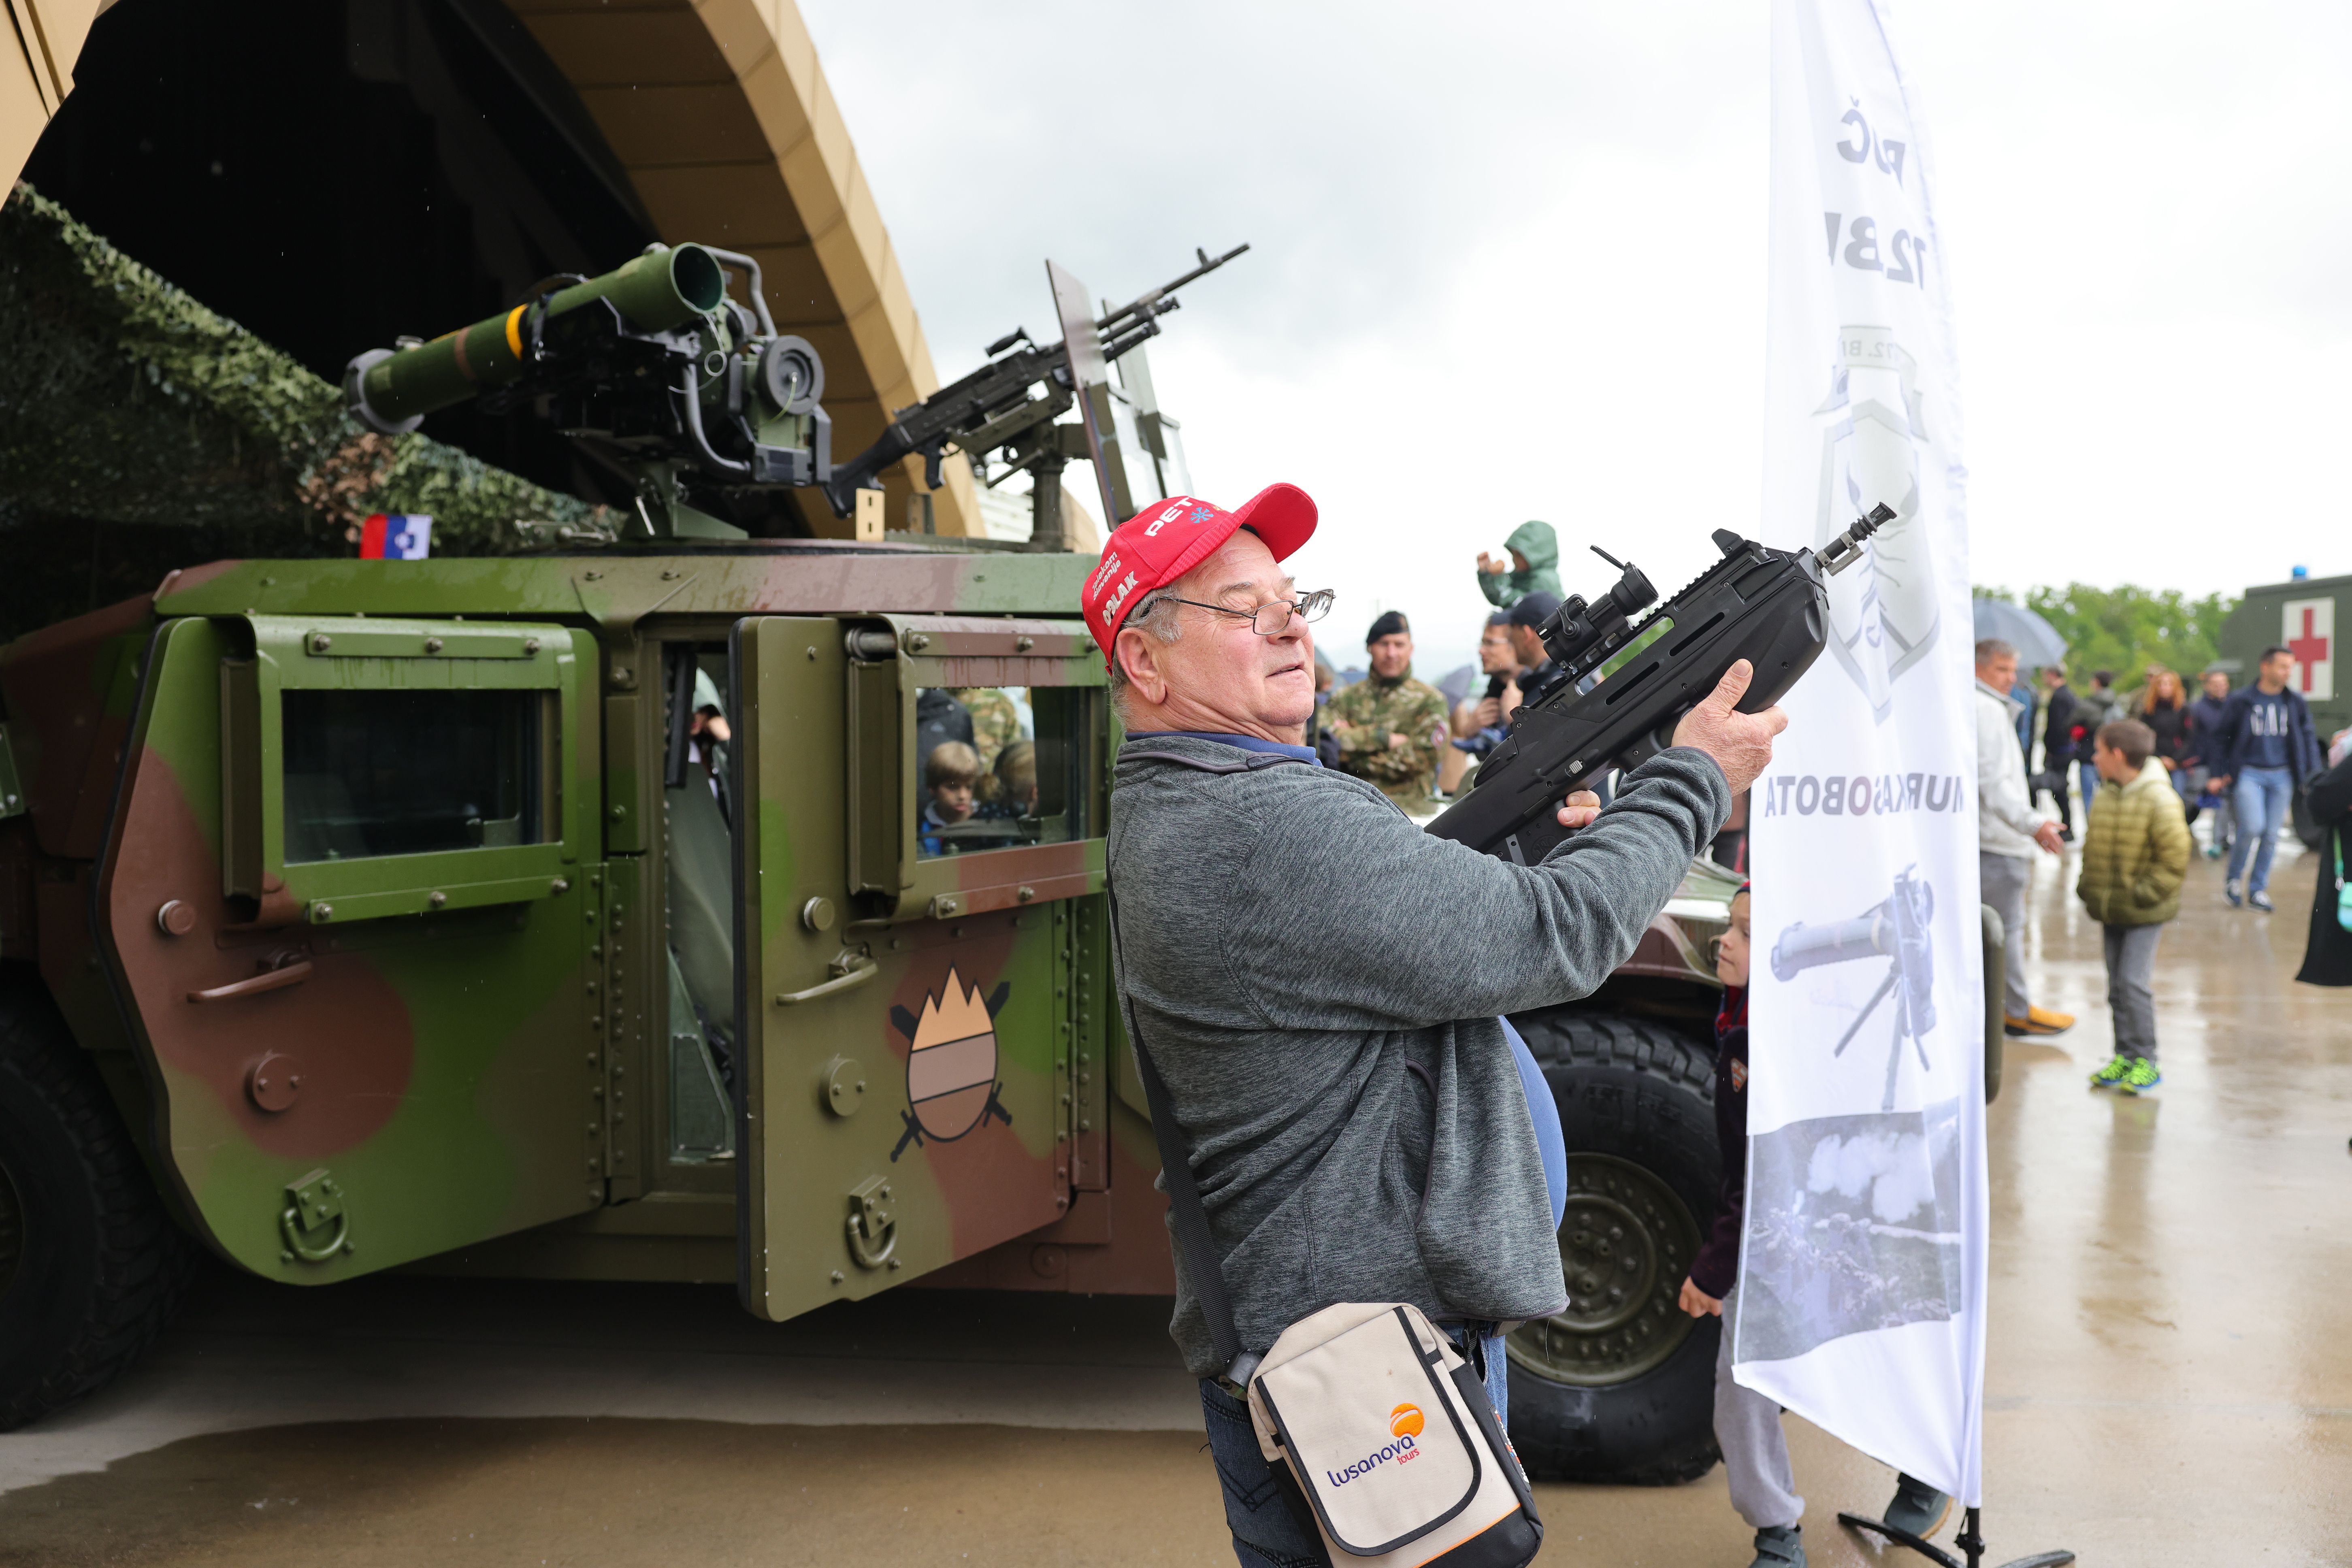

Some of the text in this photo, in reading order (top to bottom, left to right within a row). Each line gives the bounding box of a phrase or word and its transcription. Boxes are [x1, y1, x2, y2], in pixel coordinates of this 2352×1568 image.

[1144, 496, 1193, 537] PET
[1092, 551, 1118, 592] Telekom
[1093, 559, 1121, 601] Slovenije
[1327, 1436, 1415, 1487] lusanova
[1396, 1448, 1420, 1465] tours
